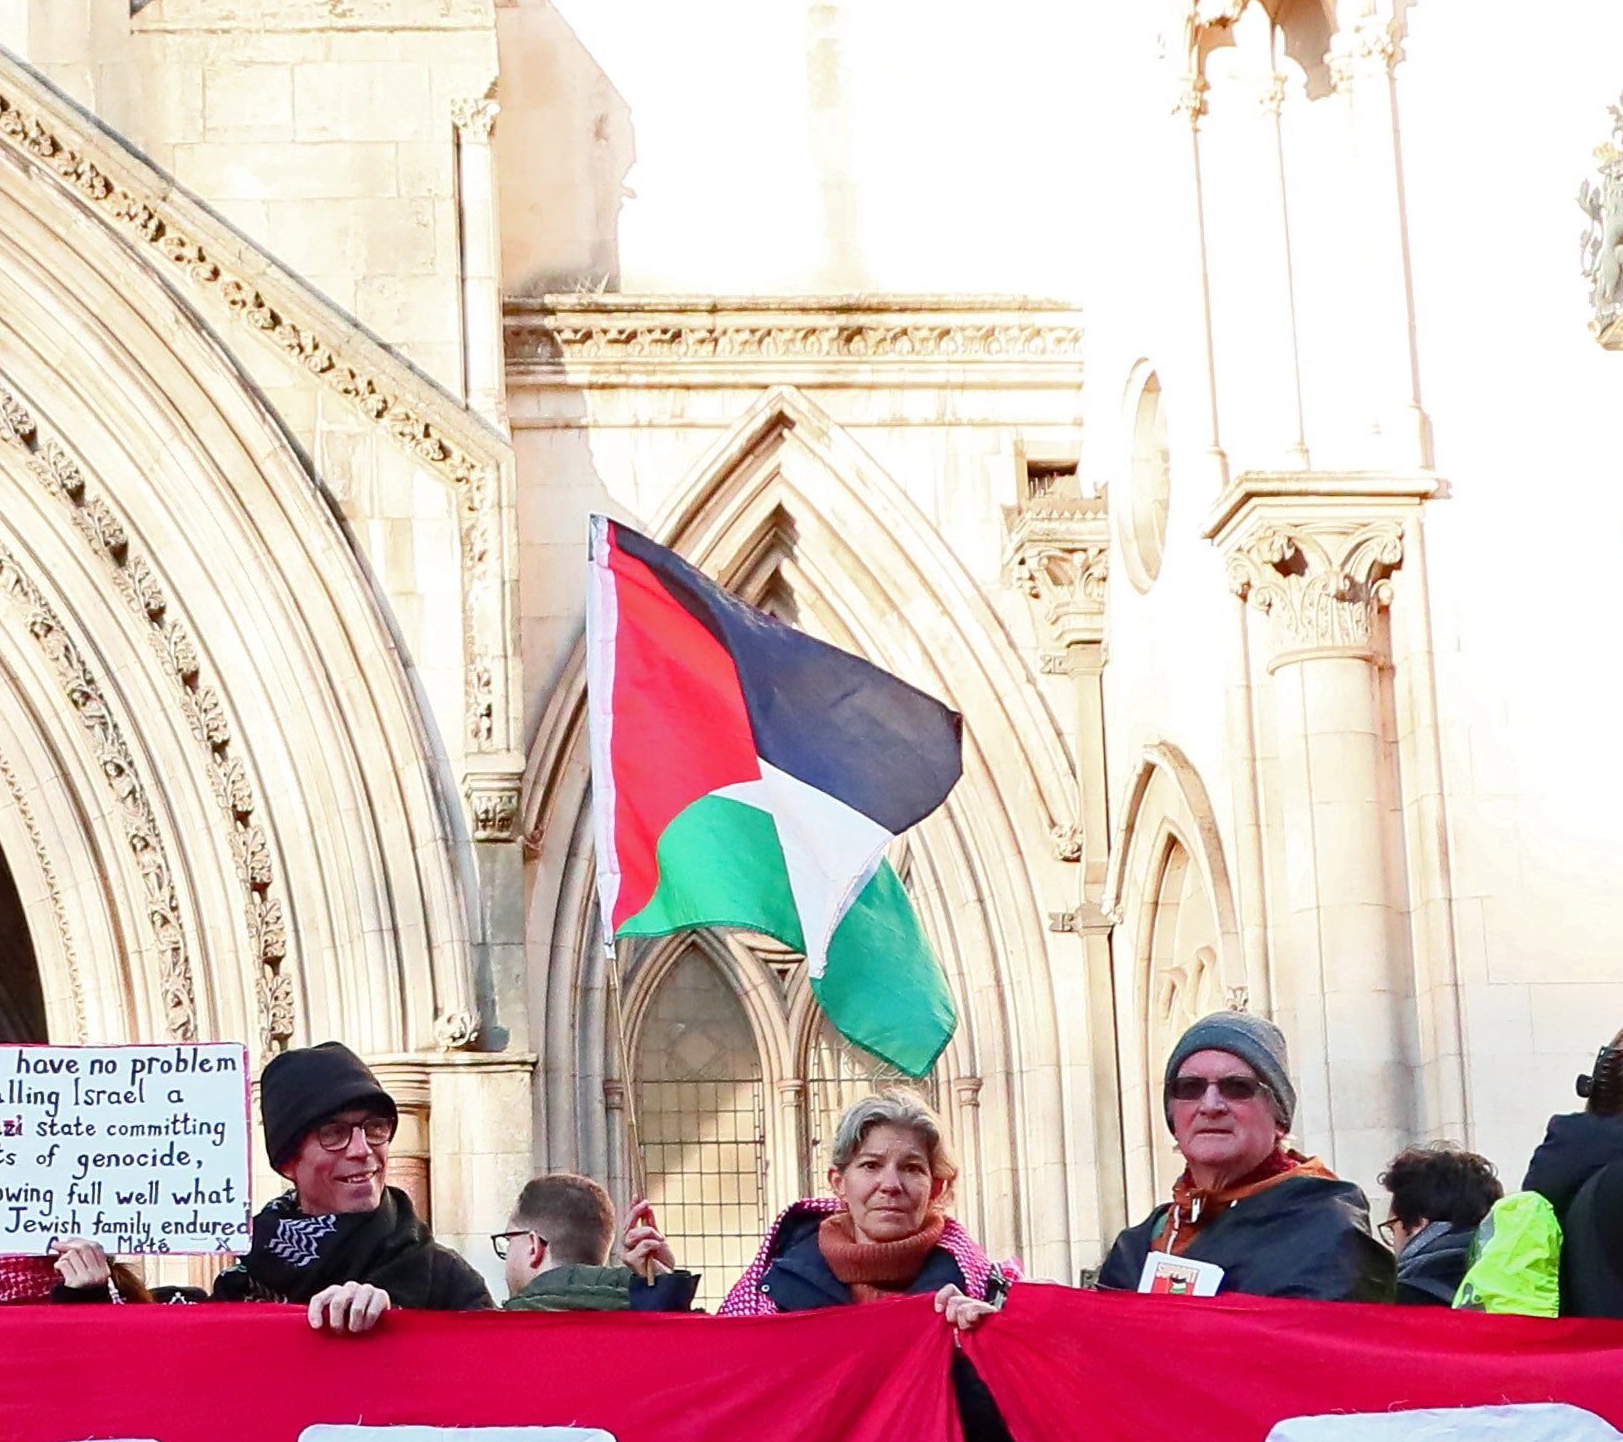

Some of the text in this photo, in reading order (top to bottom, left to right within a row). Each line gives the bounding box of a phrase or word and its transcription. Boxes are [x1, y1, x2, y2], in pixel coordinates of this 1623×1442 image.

[16, 1049, 80, 1075] have
[90, 1059, 117, 1075] no
[131, 1048, 237, 1086] problem
[73, 1077, 146, 1106] Israel
[167, 1089, 184, 1104] a
[36, 1115, 96, 1137] state
[107, 1113, 226, 1146] committing
[36, 1144, 60, 1167] of
[72, 1141, 204, 1180] genocide,
[67, 1181, 102, 1205] full
[116, 1180, 159, 1205] well
[5, 1207, 81, 1234] Jewish
[92, 1210, 151, 1243] family
